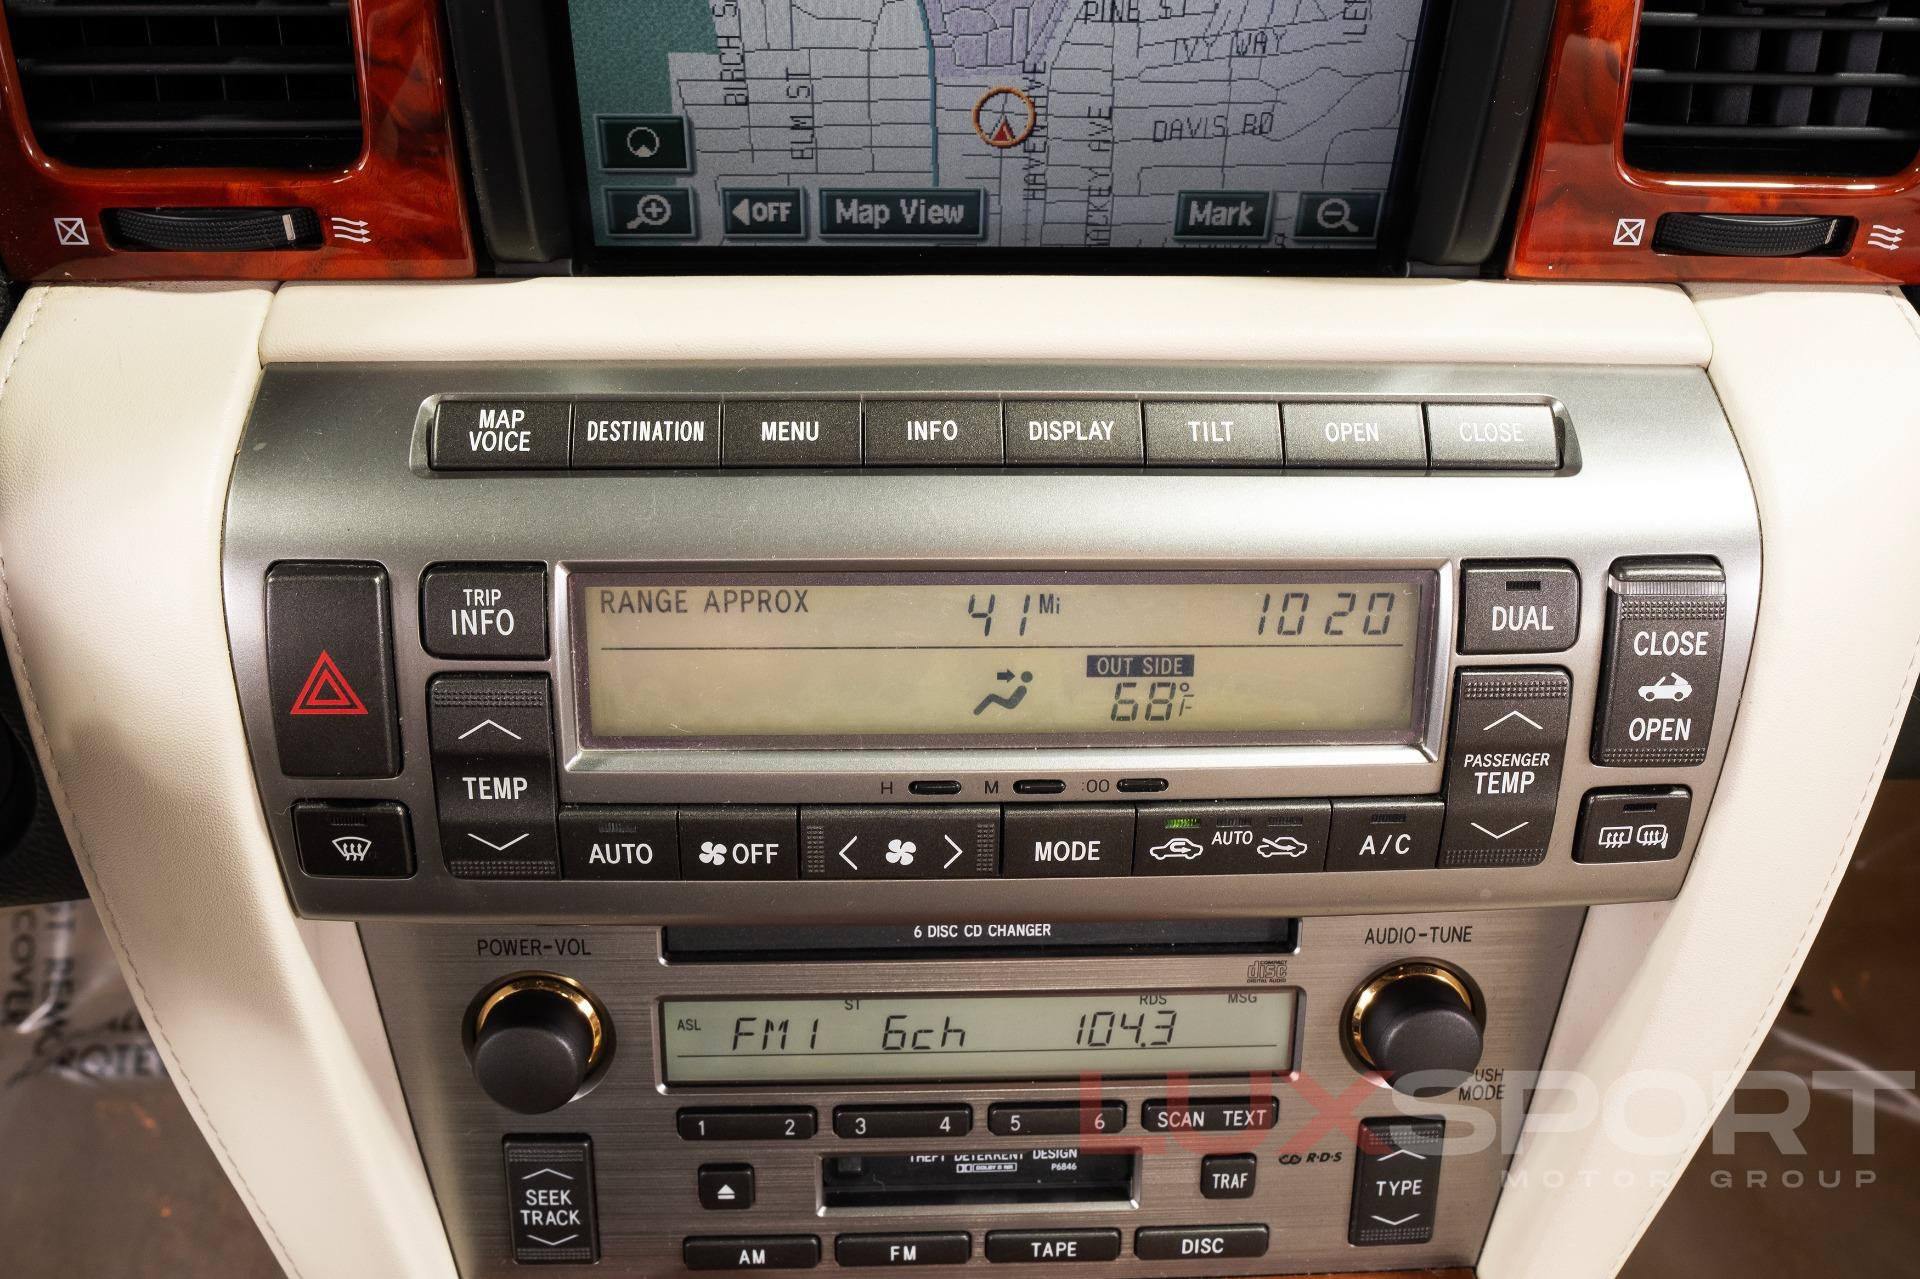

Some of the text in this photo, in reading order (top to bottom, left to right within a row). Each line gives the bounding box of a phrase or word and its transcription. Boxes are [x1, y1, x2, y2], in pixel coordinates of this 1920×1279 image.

[1082, 0, 1141, 24] PINE
[1234, 28, 1288, 56] WAY
[712, 0, 748, 106] BIRCH S
[785, 67, 815, 160] ELM ST
[1088, 106, 1114, 152] AVE
[1153, 115, 1228, 141] DAVIS
[752, 202, 792, 222] OFF
[836, 198, 965, 229] Map View
[1188, 200, 1254, 227] Mark
[479, 409, 525, 429] MAP
[586, 420, 705, 442] DESTINATION
[761, 420, 819, 441] MENU
[906, 420, 958, 442] INFO
[1028, 420, 1115, 442] DISPLAY
[1188, 420, 1233, 442] TILT
[1325, 421, 1380, 443] OPEN
[1459, 421, 1524, 443] CLOSE
[469, 431, 531, 452] VOICE
[462, 588, 502, 607] TRIP
[450, 608, 515, 637] INFO
[600, 588, 1061, 637] RANGE APPROX 41 Mi
[1491, 605, 1555, 632] DUAL
[1633, 630, 1709, 657] CLOSE
[1097, 656, 1184, 675] OUT SIDE
[1628, 717, 1692, 742] OPEN
[1464, 752, 1550, 768] PASSENGER
[462, 776, 529, 800] TEMP
[881, 781, 893, 795] H
[984, 780, 999, 795] M
[1474, 771, 1535, 795] TEMP
[1211, 830, 1254, 846] AUTO
[1359, 833, 1411, 857] A/C
[588, 842, 653, 866] AUTO
[732, 842, 779, 866] OFF
[1034, 840, 1101, 863] MODE
[913, 923, 1052, 938] 6 DISC CD CHANGER
[1364, 925, 1473, 946] AUDIO-TUNE
[477, 937, 592, 957] POWER-VOL
[1139, 994, 1168, 1006] RDS
[1227, 993, 1258, 1004] MSG
[677, 1018, 701, 1032] ASL
[881, 1014, 967, 1051] 6ch
[1075, 1010, 1178, 1048] 104.3
[1475, 1068, 1505, 1082] USH
[1458, 1084, 1506, 1102] MODE
[697, 1120, 705, 1136] 1
[784, 1119, 796, 1136] 2
[855, 1118, 866, 1135] 3
[939, 1116, 951, 1133] 4
[1010, 1115, 1021, 1132] 5
[1094, 1114, 1105, 1130] 6
[1156, 1109, 1267, 1128] SCAN TEXT
[1033, 1148, 1078, 1160] DESIGN
[1051, 1162, 1078, 1171] P6846
[1212, 1173, 1249, 1190] TRAF
[1375, 1179, 1422, 1197] TYPE
[525, 1189, 572, 1206] SEEK
[520, 1209, 581, 1225] TRACK
[890, 1245, 917, 1262] FM
[1031, 1241, 1077, 1257] TAPE
[1181, 1238, 1224, 1254] DISC
[738, 1249, 766, 1265] AM
